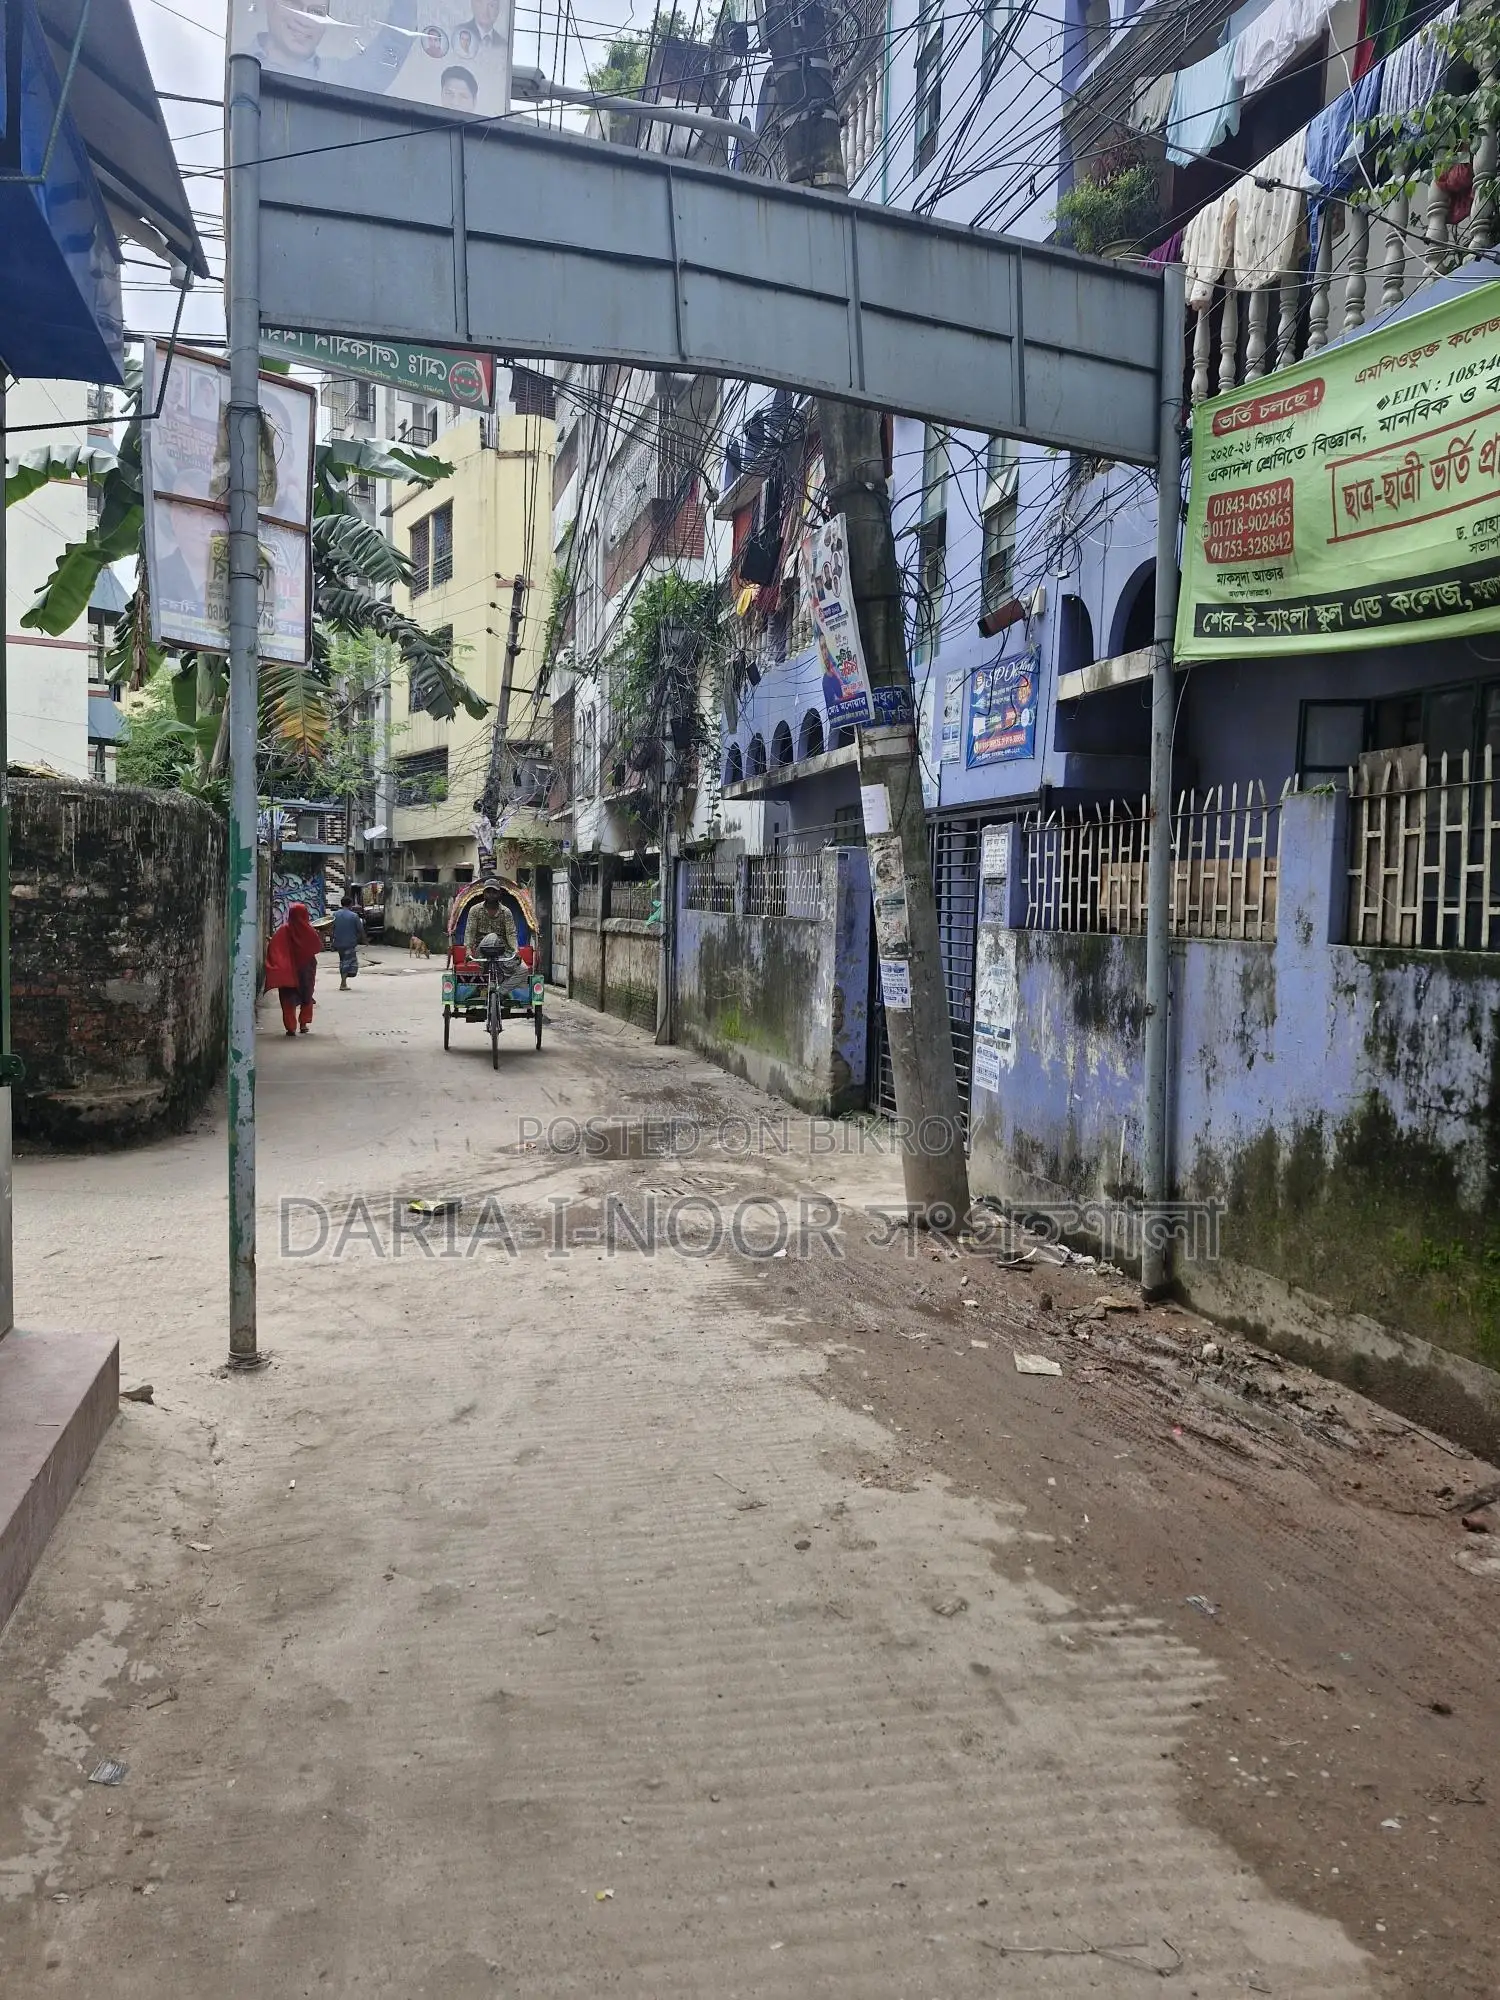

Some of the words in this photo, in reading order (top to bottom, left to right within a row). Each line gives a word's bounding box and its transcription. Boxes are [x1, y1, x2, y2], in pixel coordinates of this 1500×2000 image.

[1354, 339, 1442, 384] এমপিওভুক্ত
[1391, 379, 1432, 405] EIIN
[1218, 402, 1255, 429] ভর্তি
[1259, 391, 1310, 418] চলছে
[1208, 459, 1252, 483] একাদশ
[1378, 395, 1453, 432] মানবিক
[1460, 387, 1477, 404] ও
[1210, 441, 1252, 462] ২০২৫-২৬
[1342, 450, 1425, 522] ছাত্র-ছাত্রী
[1429, 429, 1476, 492] ভর্তি
[1213, 484, 1291, 517] 01843-055814
[1212, 507, 1291, 537] 01718-902465
[1473, 514, 1500, 536] মোহা
[1211, 531, 1291, 559] 01753-328842
[1314, 601, 1344, 633] স্কুল
